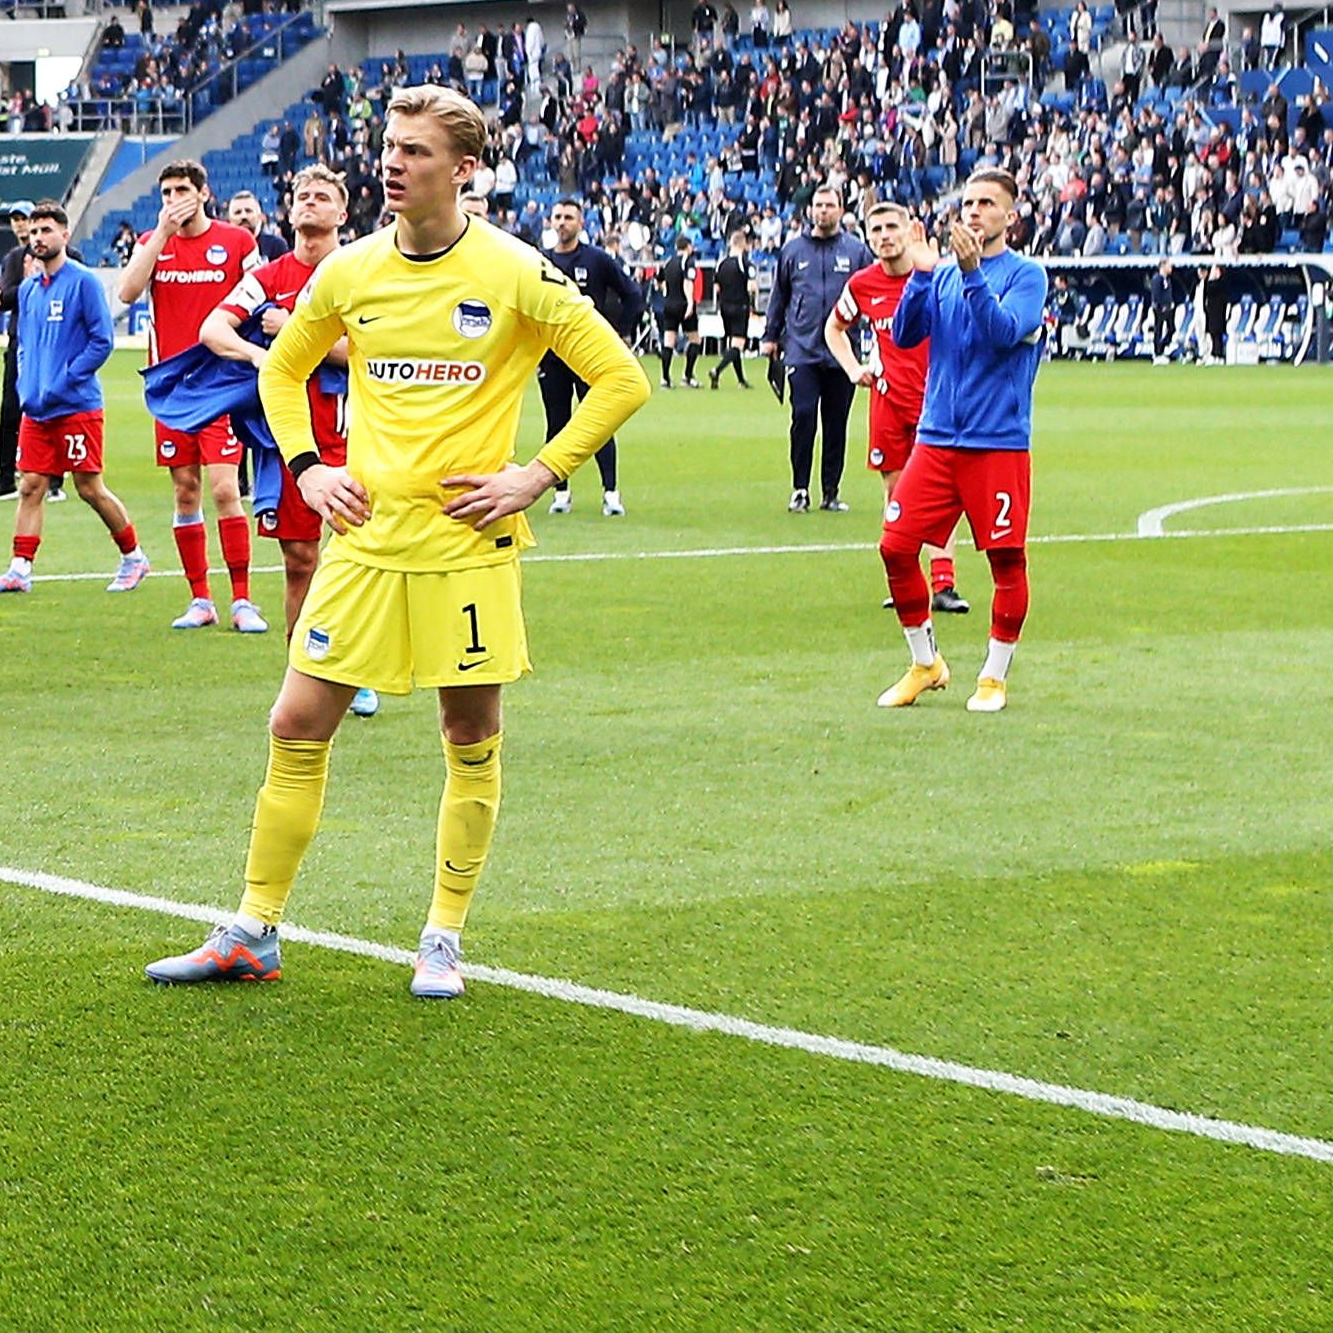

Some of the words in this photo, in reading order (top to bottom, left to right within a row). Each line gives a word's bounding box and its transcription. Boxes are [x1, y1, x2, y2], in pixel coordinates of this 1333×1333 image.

[155, 269, 226, 283] AUTOHERO
[367, 361, 483, 382] AUTOHERO
[64, 434, 87, 460] 23
[995, 492, 1011, 527] 2
[462, 603, 487, 654] 1
